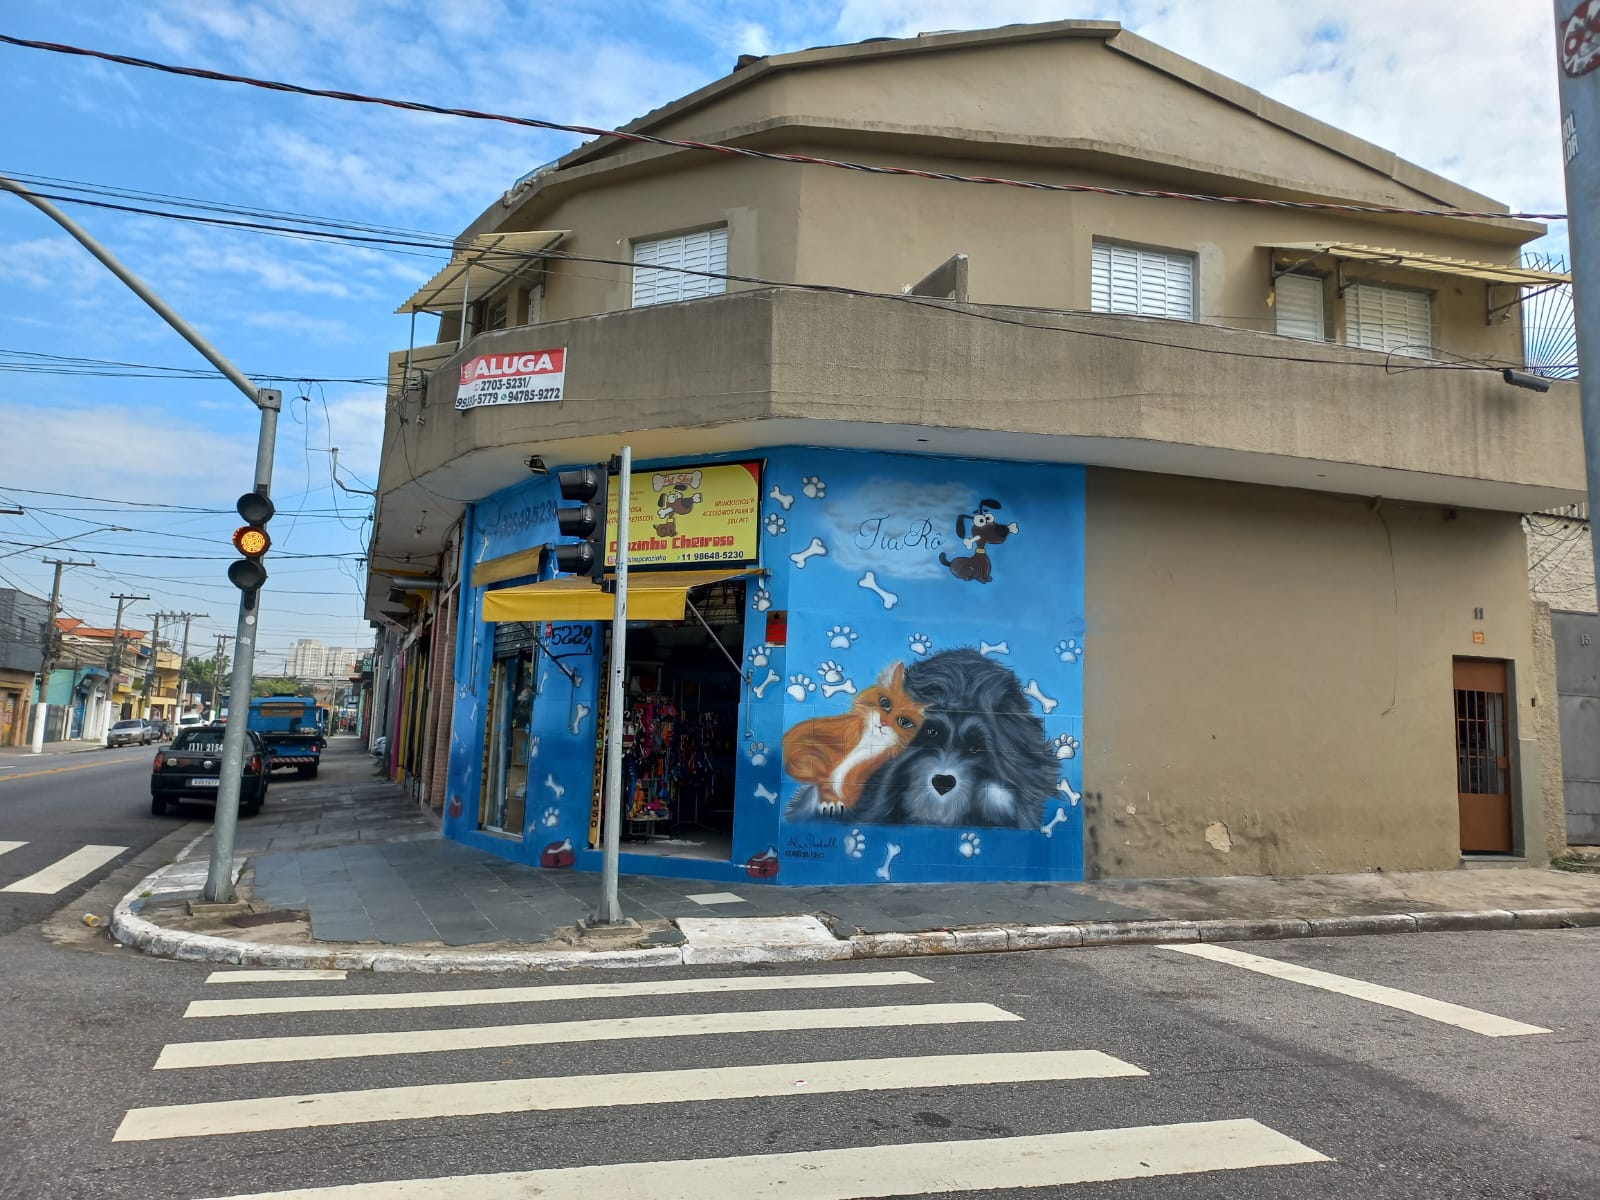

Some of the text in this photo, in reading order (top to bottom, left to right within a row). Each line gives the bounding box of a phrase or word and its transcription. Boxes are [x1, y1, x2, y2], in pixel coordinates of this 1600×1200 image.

[475, 353, 554, 377] ALUGA
[507, 387, 561, 403] 94785-9272
[714, 498, 749, 507] BRINQUEDOS
[609, 534, 734, 553] Czinho Cheiroso
[681, 553, 691, 561] 11
[693, 550, 744, 561] 98648-5230
[551, 624, 593, 646] 5229
[188, 742, 203, 753] (11)
